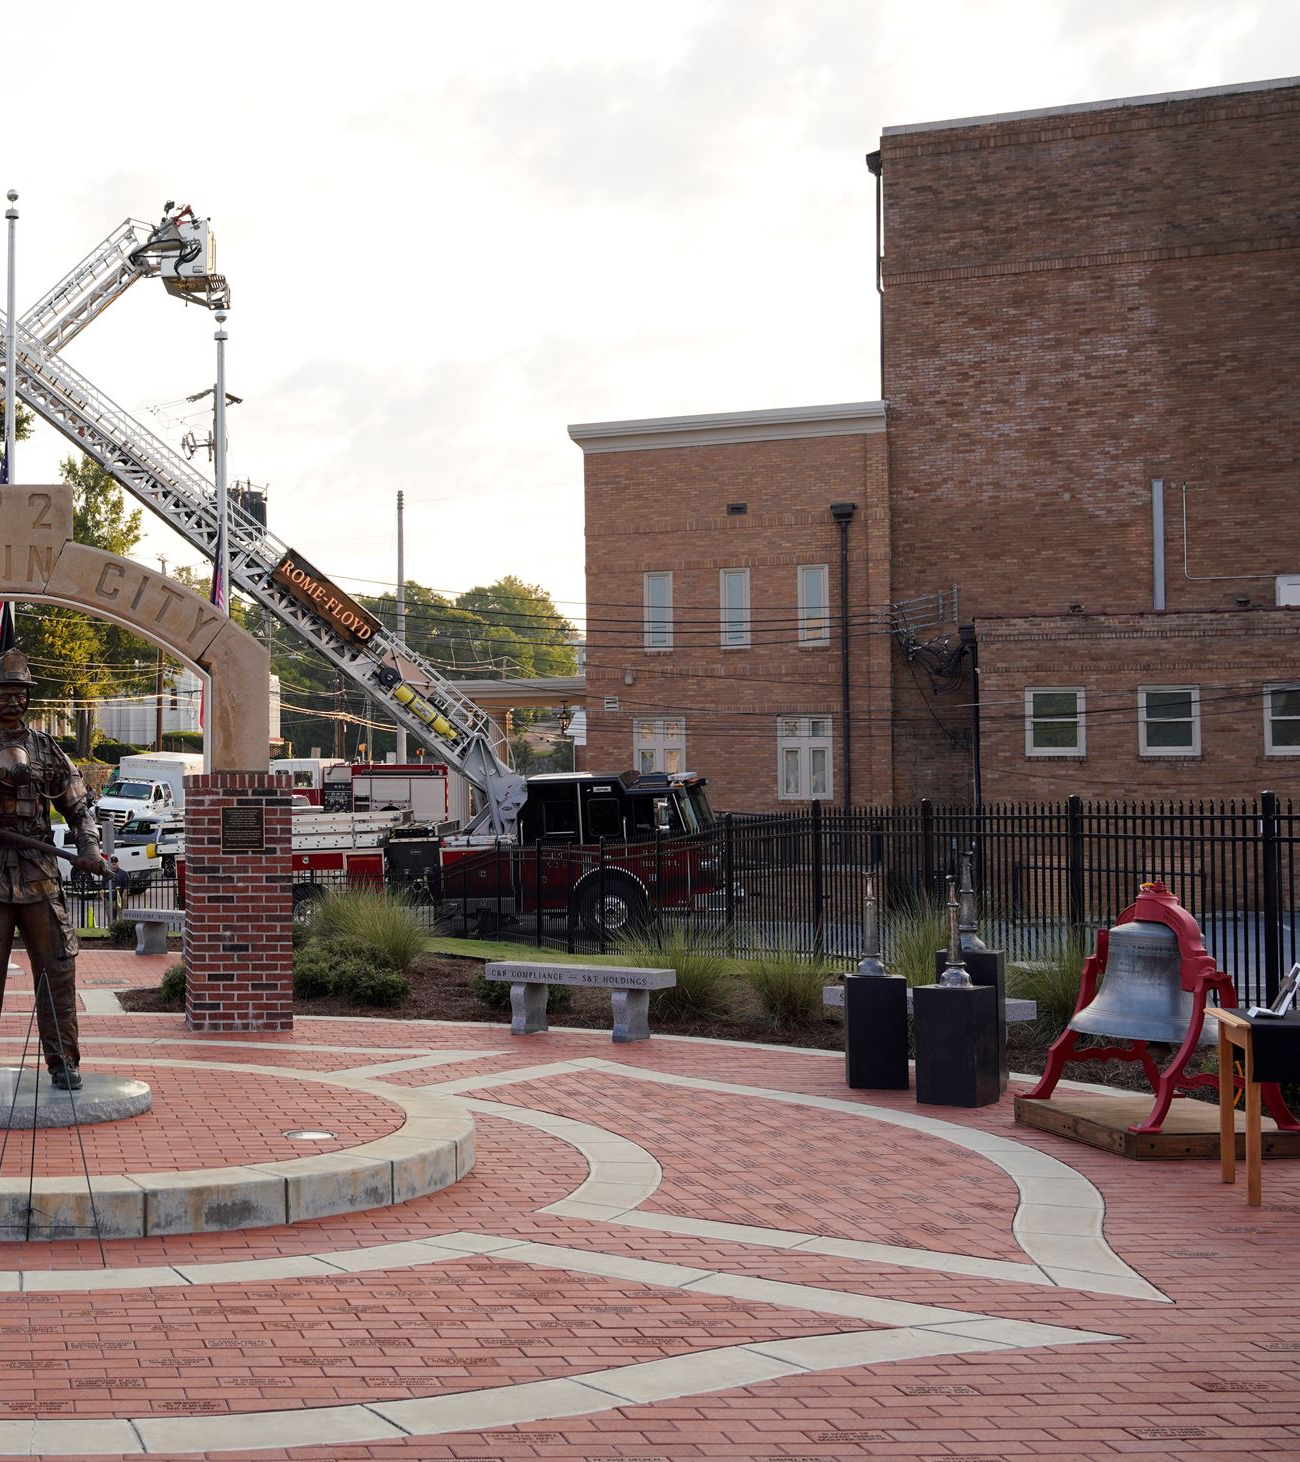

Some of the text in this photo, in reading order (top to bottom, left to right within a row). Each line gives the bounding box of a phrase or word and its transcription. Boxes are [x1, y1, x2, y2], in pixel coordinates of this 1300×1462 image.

[27, 492, 53, 530] 2
[94, 561, 219, 644] CITY
[280, 559, 372, 640] ROME-FLOYD
[491, 969, 507, 977] C&R
[511, 970, 564, 981] COMPLIANCE
[582, 974, 598, 983] S&T
[603, 976, 647, 986] HOLDINGS
